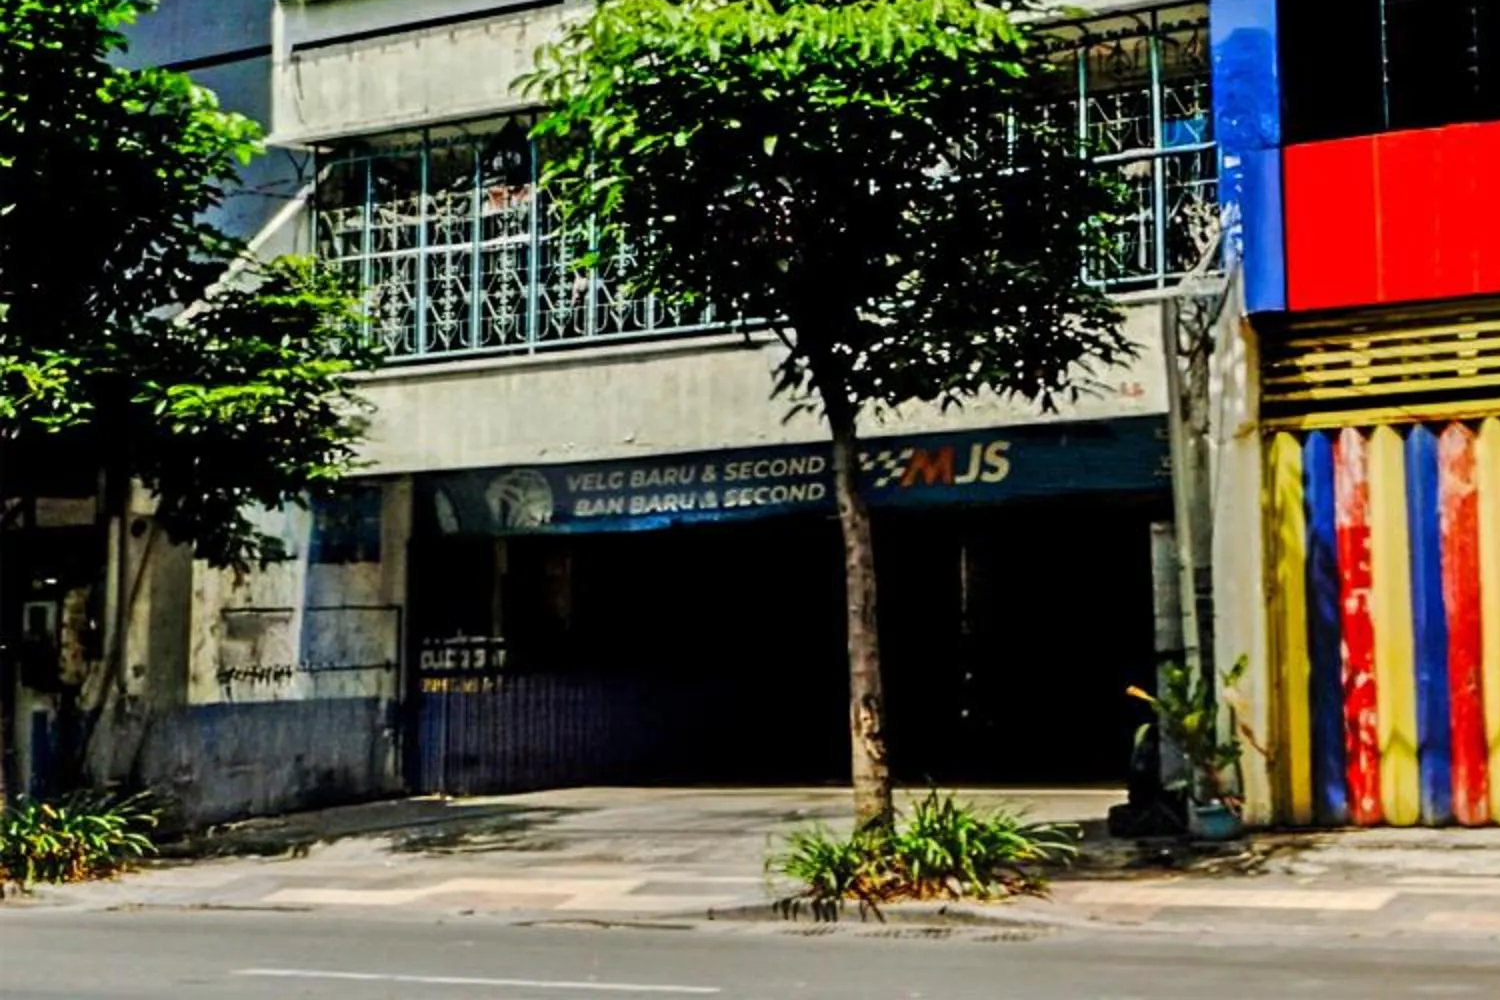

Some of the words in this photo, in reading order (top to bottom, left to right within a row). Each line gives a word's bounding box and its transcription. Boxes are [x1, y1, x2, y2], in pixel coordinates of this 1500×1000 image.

[566, 471, 625, 492] VELG
[629, 465, 696, 489] BARU
[701, 464, 717, 484] &
[723, 456, 826, 482] SECOND
[902, 440, 1012, 487] MJS
[573, 498, 624, 517] BAN
[628, 492, 697, 515] BARU
[723, 483, 826, 508] SECOND
